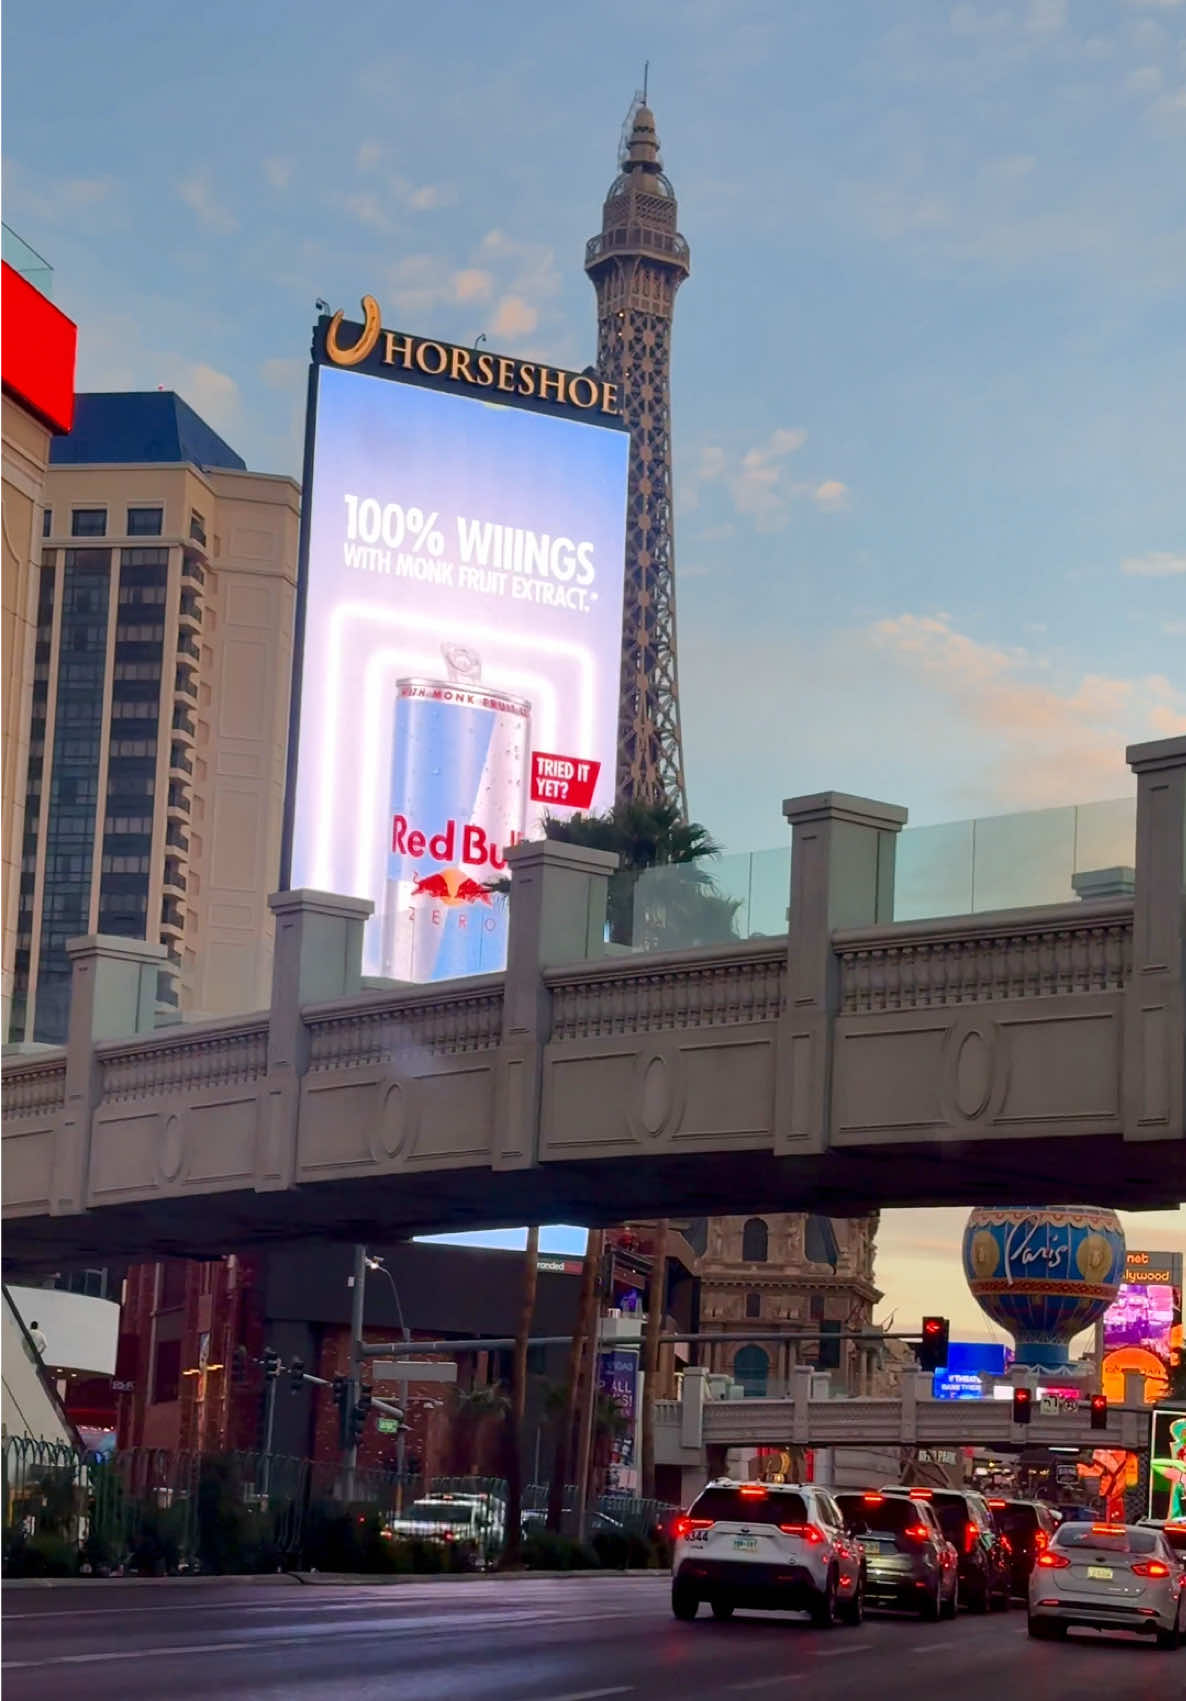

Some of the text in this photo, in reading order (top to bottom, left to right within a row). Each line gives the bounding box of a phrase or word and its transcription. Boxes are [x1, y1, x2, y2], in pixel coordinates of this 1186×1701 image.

[383, 333, 622, 415] HORSESHOE
[343, 494, 595, 585] 100% WIIINGS
[343, 541, 391, 575] WITH
[395, 552, 456, 587] MONK
[458, 565, 506, 597] FRUIT
[432, 689, 474, 705] MONK
[536, 757, 591, 783] TRIED IT
[535, 777, 569, 800] YET?
[392, 815, 455, 861] Red
[408, 906, 497, 933] ZERO
[1004, 1214, 1070, 1286] Paris
[1123, 1268, 1170, 1283] lywood
